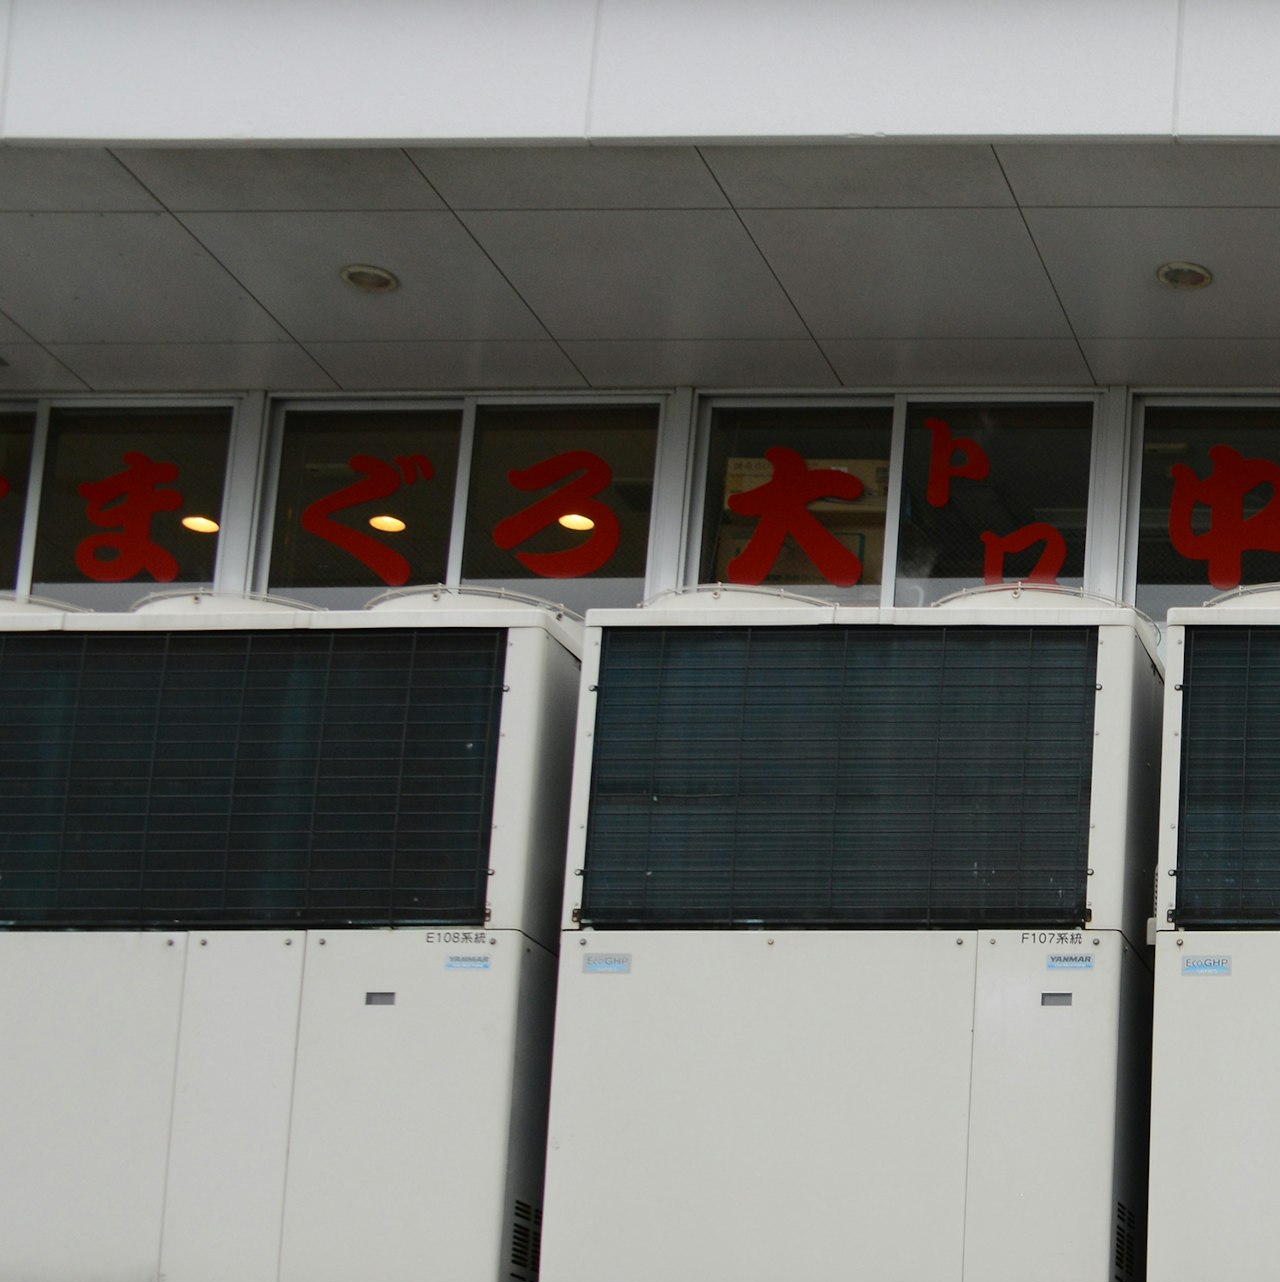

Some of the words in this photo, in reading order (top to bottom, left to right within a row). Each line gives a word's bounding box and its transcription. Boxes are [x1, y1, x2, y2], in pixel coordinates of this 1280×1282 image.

[76, 452, 622, 586] まぐろ
[425, 931, 487, 945] E108系統
[1021, 932, 1083, 945] F107系統
[1050, 955, 1092, 963] YANMAR
